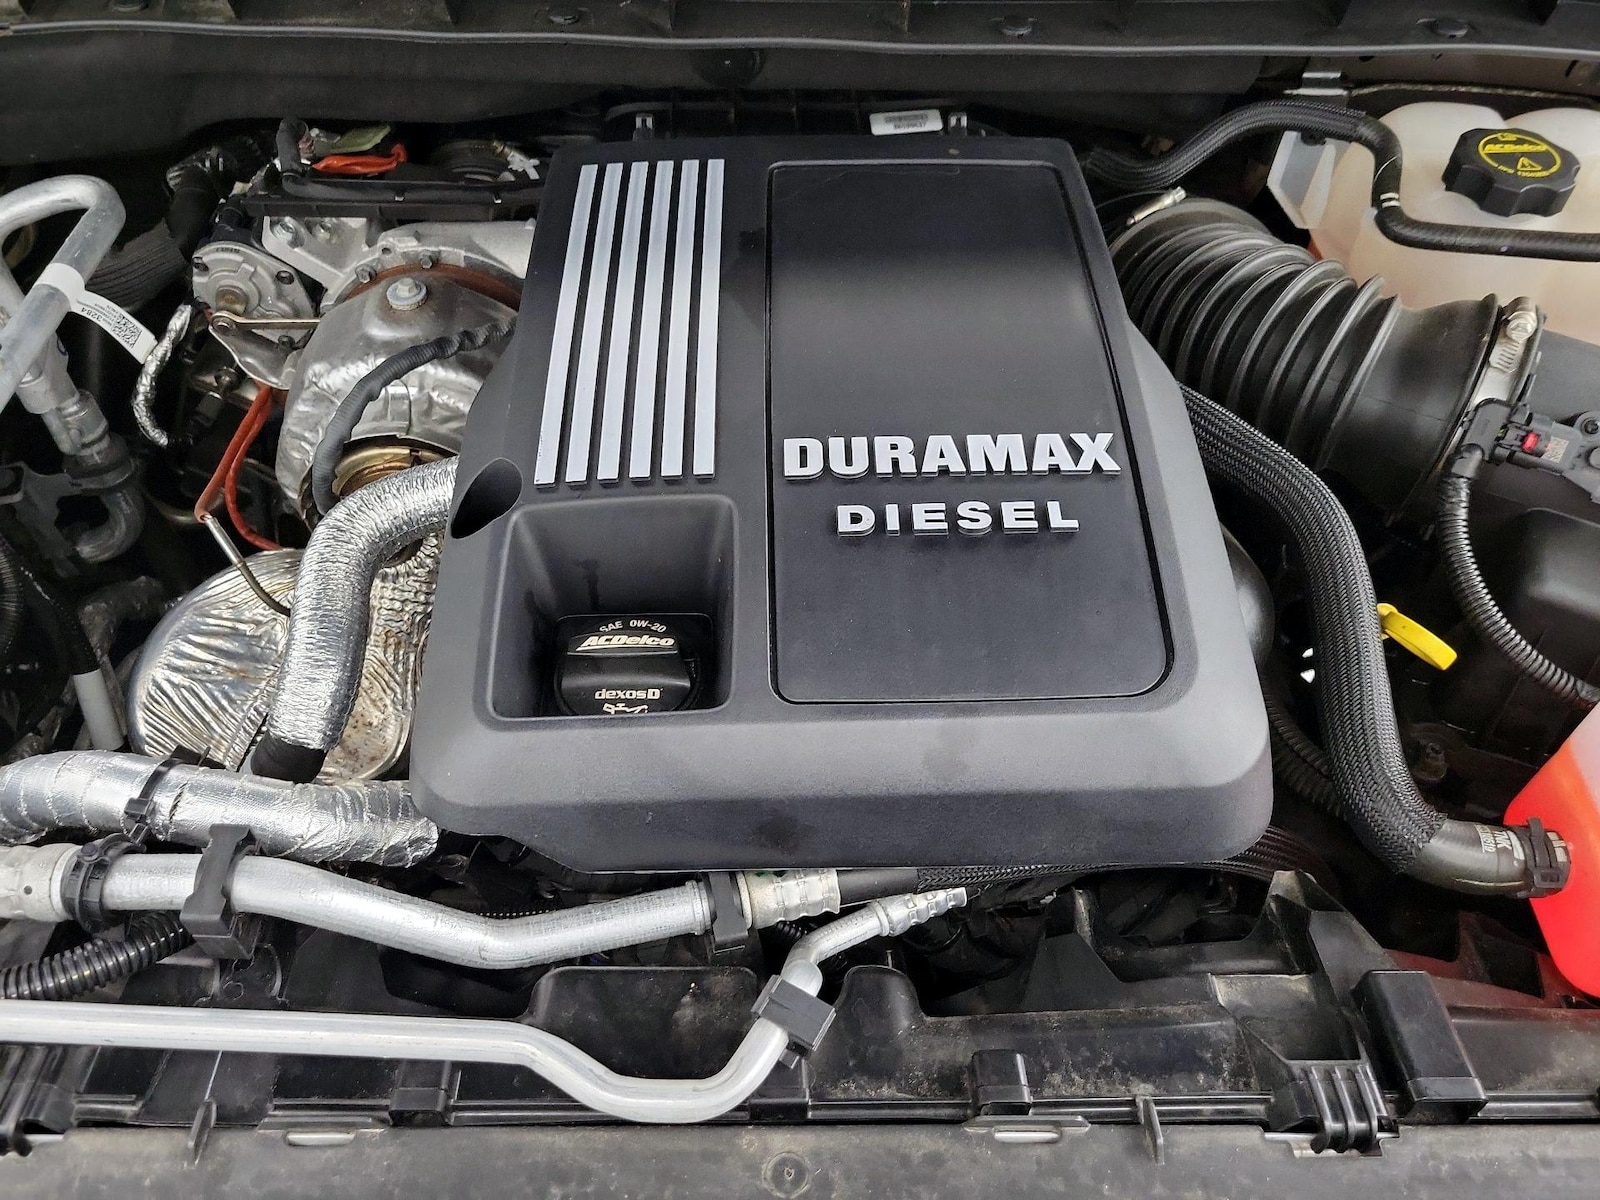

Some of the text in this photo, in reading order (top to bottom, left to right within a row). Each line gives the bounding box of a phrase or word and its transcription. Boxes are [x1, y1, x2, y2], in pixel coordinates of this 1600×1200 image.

[783, 433, 1121, 480] DURAMAX
[837, 500, 1079, 536] DIESEL
[599, 619, 667, 633] SAE 0W-20
[579, 634, 675, 648] ACDelco
